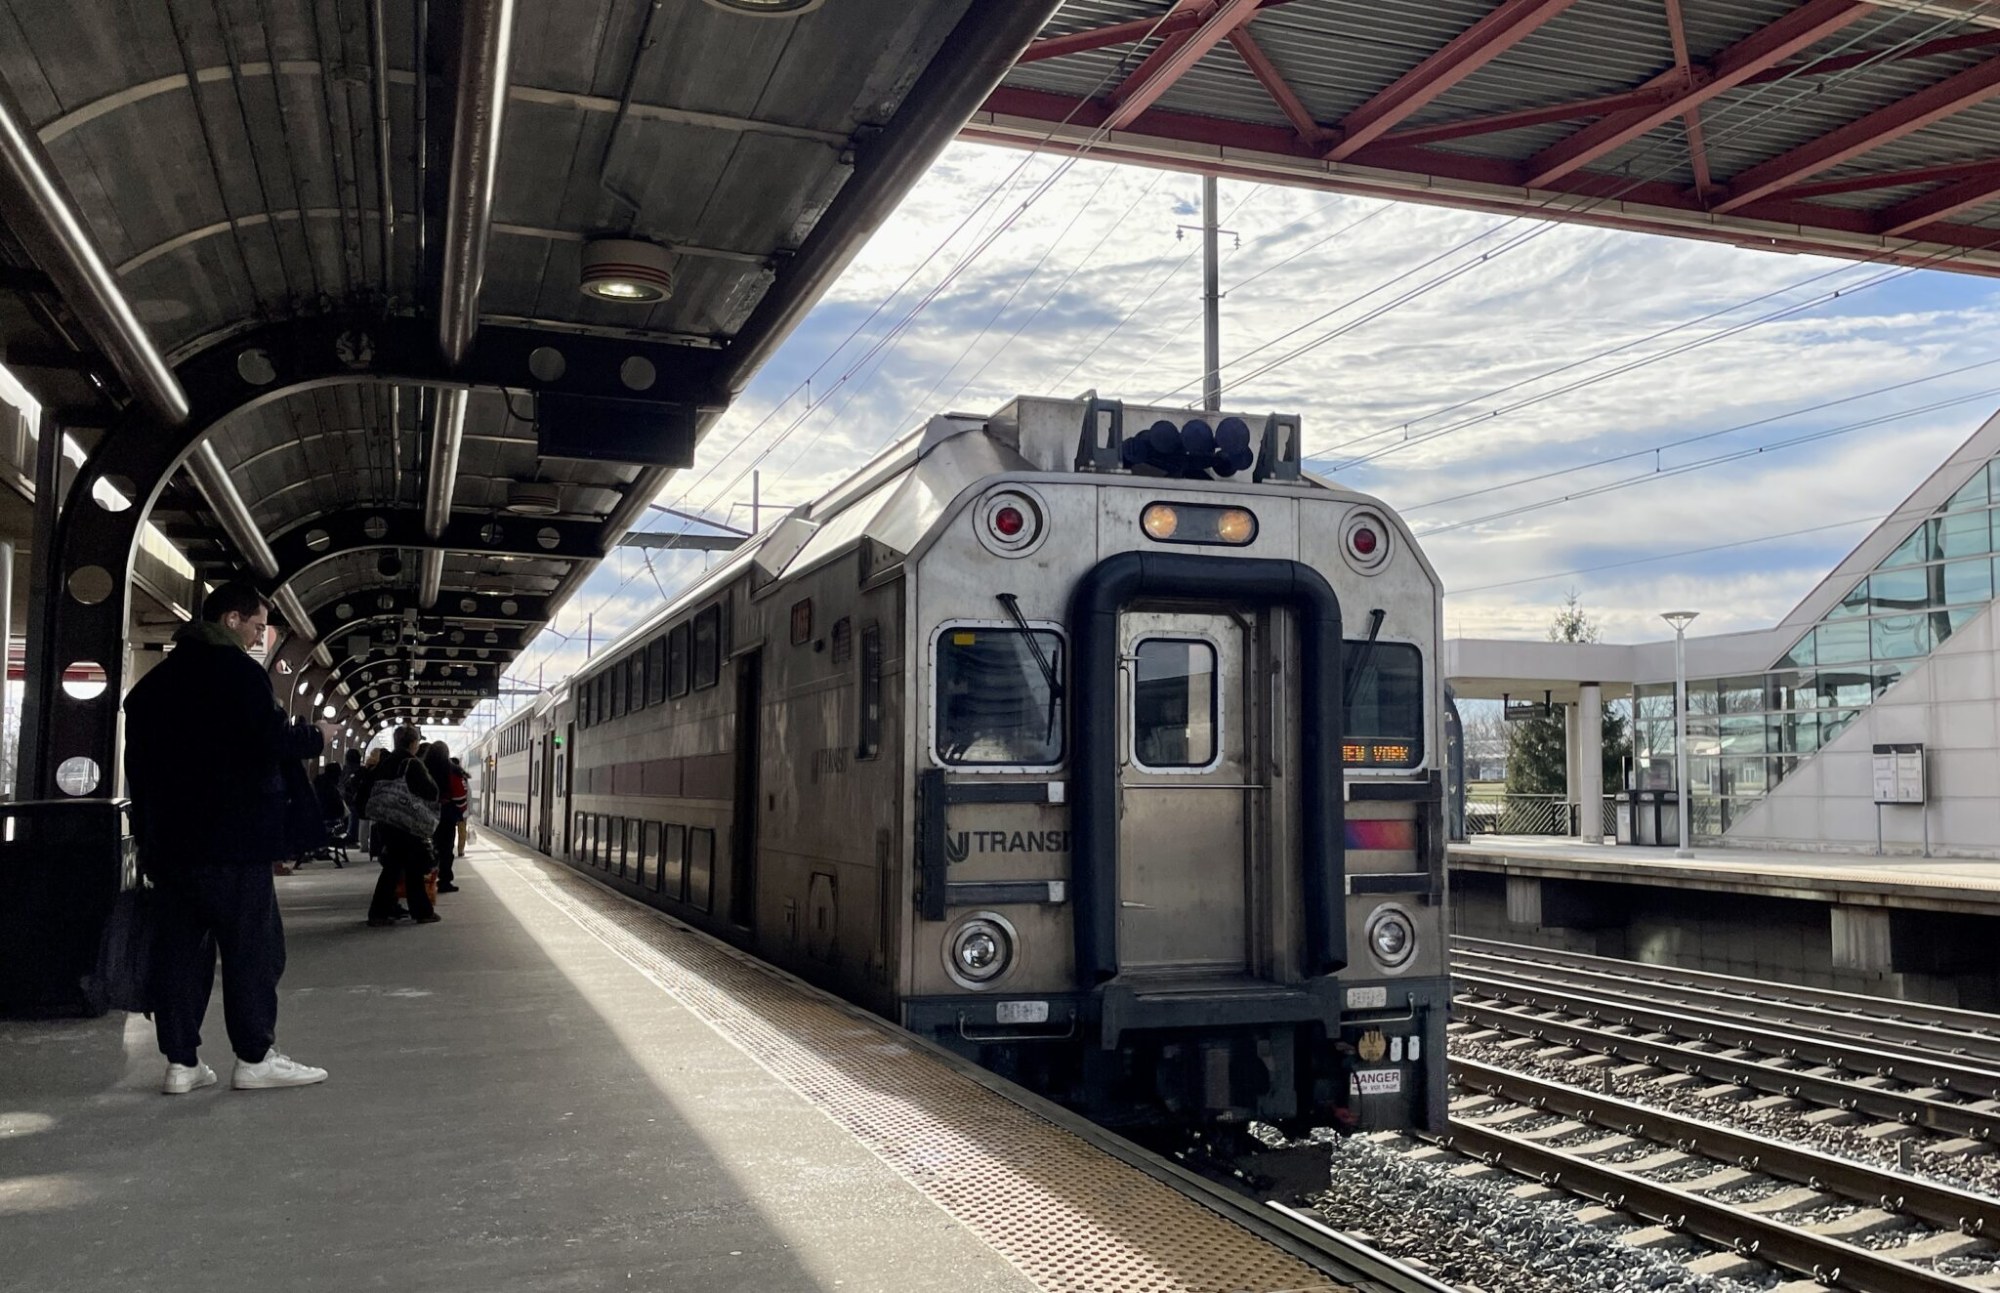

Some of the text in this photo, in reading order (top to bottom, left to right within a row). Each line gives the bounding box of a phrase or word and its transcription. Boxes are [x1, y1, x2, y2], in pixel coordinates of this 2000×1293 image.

[452, 688, 478, 696] Parking
[1373, 745, 1408, 762] YORK
[973, 830, 1071, 853] TRANSI
[1352, 1071, 1400, 1085] DANGER
